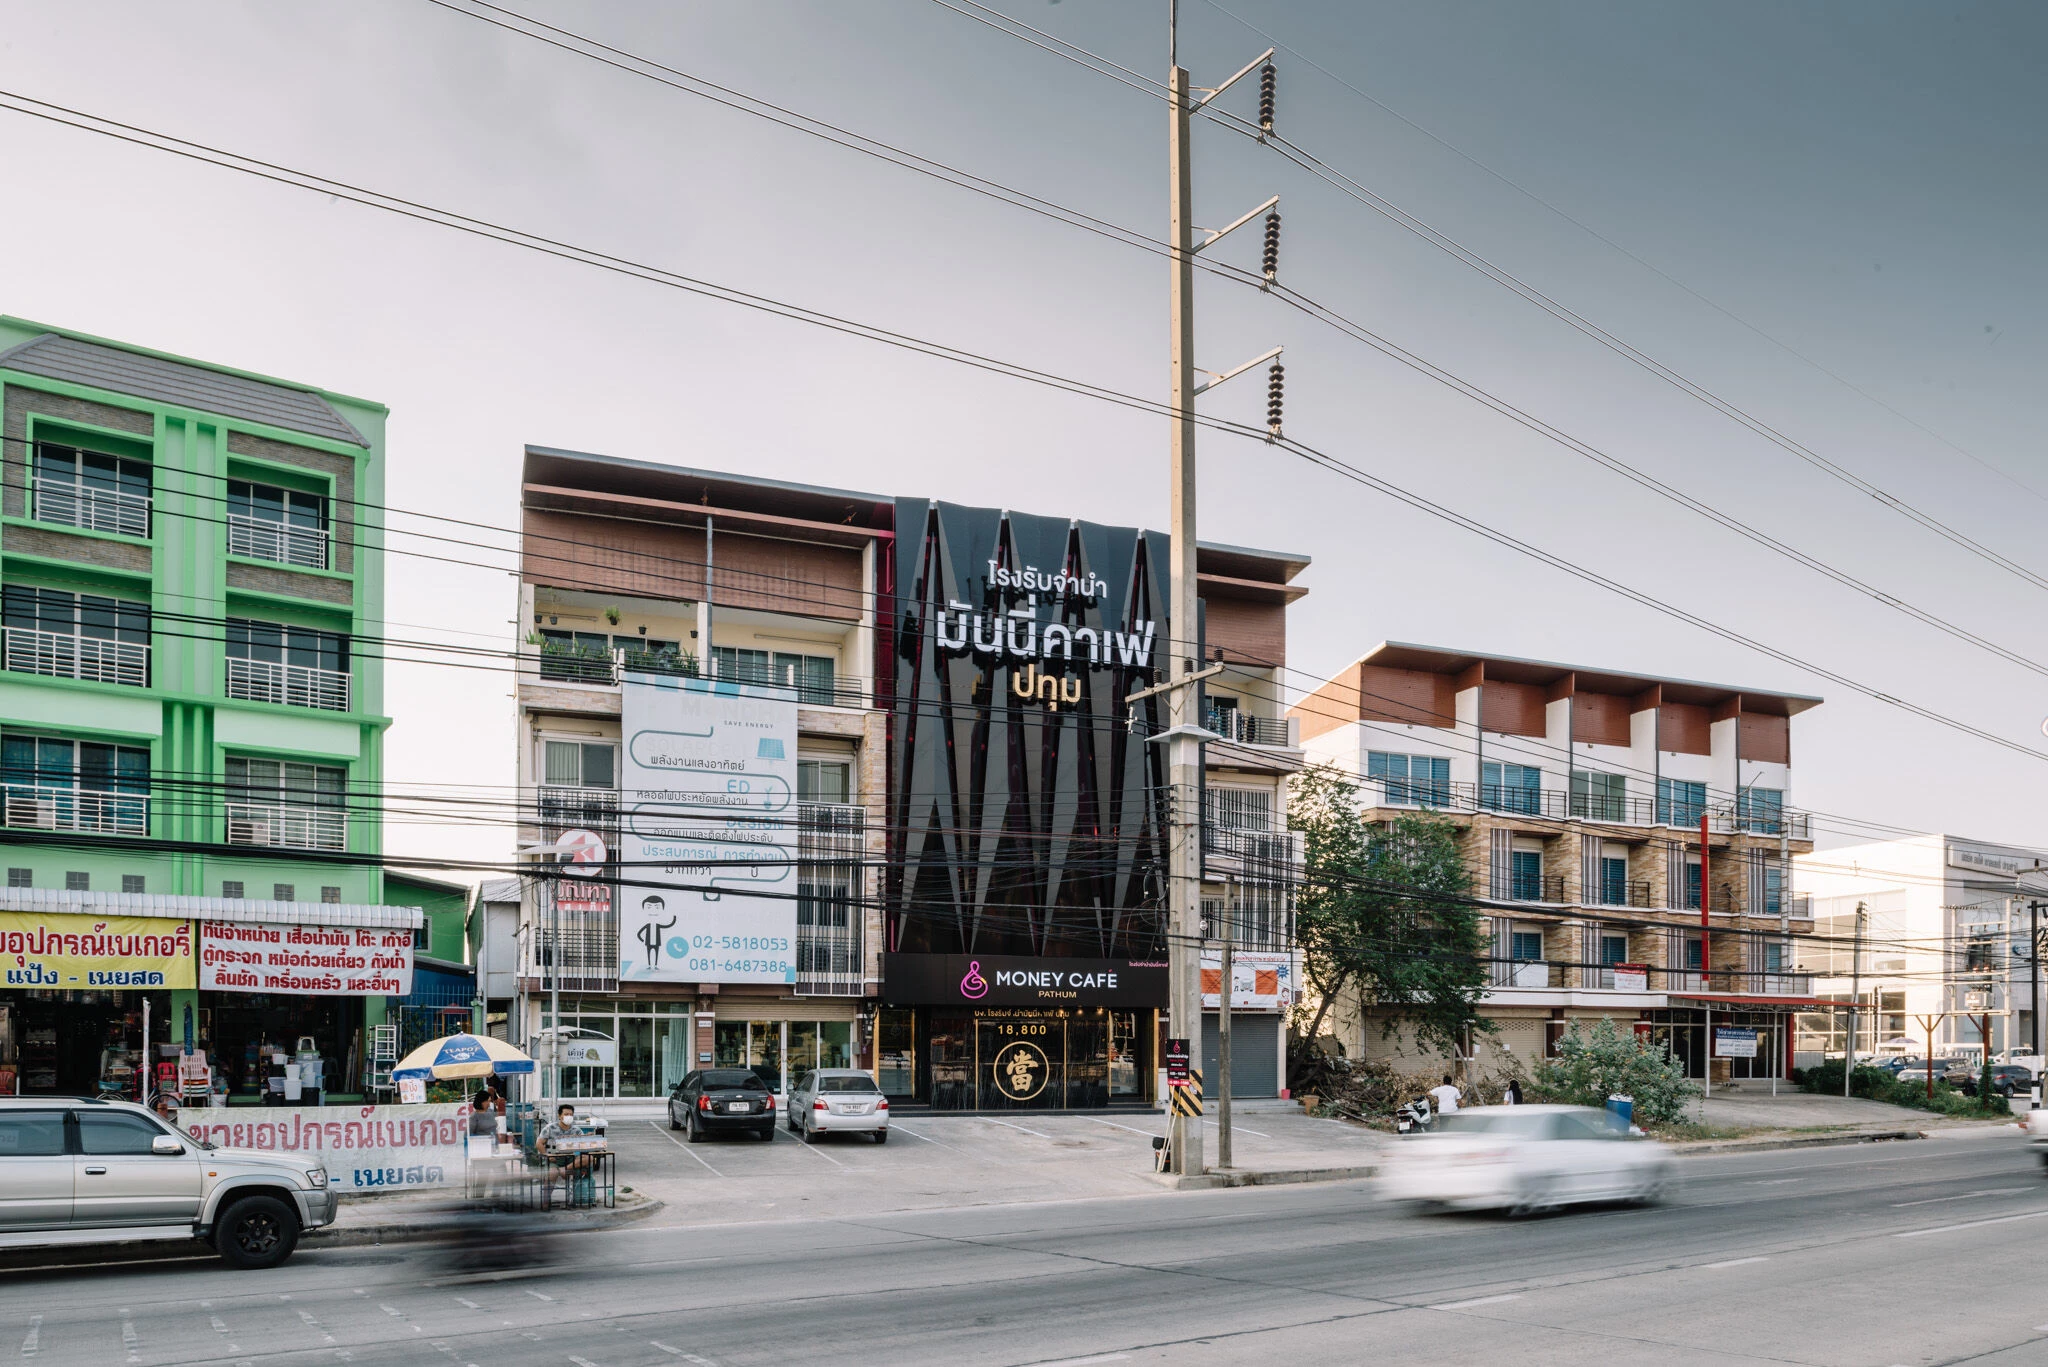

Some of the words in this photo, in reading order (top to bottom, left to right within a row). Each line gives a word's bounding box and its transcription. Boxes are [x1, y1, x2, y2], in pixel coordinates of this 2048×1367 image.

[988, 559, 1108, 599] โรงรับจำนำ
[937, 593, 1155, 667] มันนี่คาเฟ่
[1013, 663, 1082, 712] ปทุม
[745, 721, 774, 729] ENERGY
[650, 754, 746, 771] พลังงานแสงอาทิตย์
[642, 844, 718, 859] ประสบการณ์
[355, 928, 377, 947] โต๊ะ
[693, 935, 788, 951] 02-5818053
[203, 944, 263, 966] ตู้กระจก
[8, 962, 58, 985] แป้ง
[88, 970, 164, 986] เนยสด
[689, 958, 787, 973] 081-6487388
[214, 964, 259, 987] ลิ้นชัก
[264, 969, 342, 991] เครื่องครัว
[347, 971, 401, 994] และอื่นๆ
[996, 971, 1065, 988] MONEY
[1069, 969, 1118, 989] CAFÉ
[1038, 990, 1077, 999] PATHUM
[998, 1025, 1047, 1036] 18,800
[1006, 1049, 1039, 1092] 當
[354, 1164, 444, 1188] เนยสด
